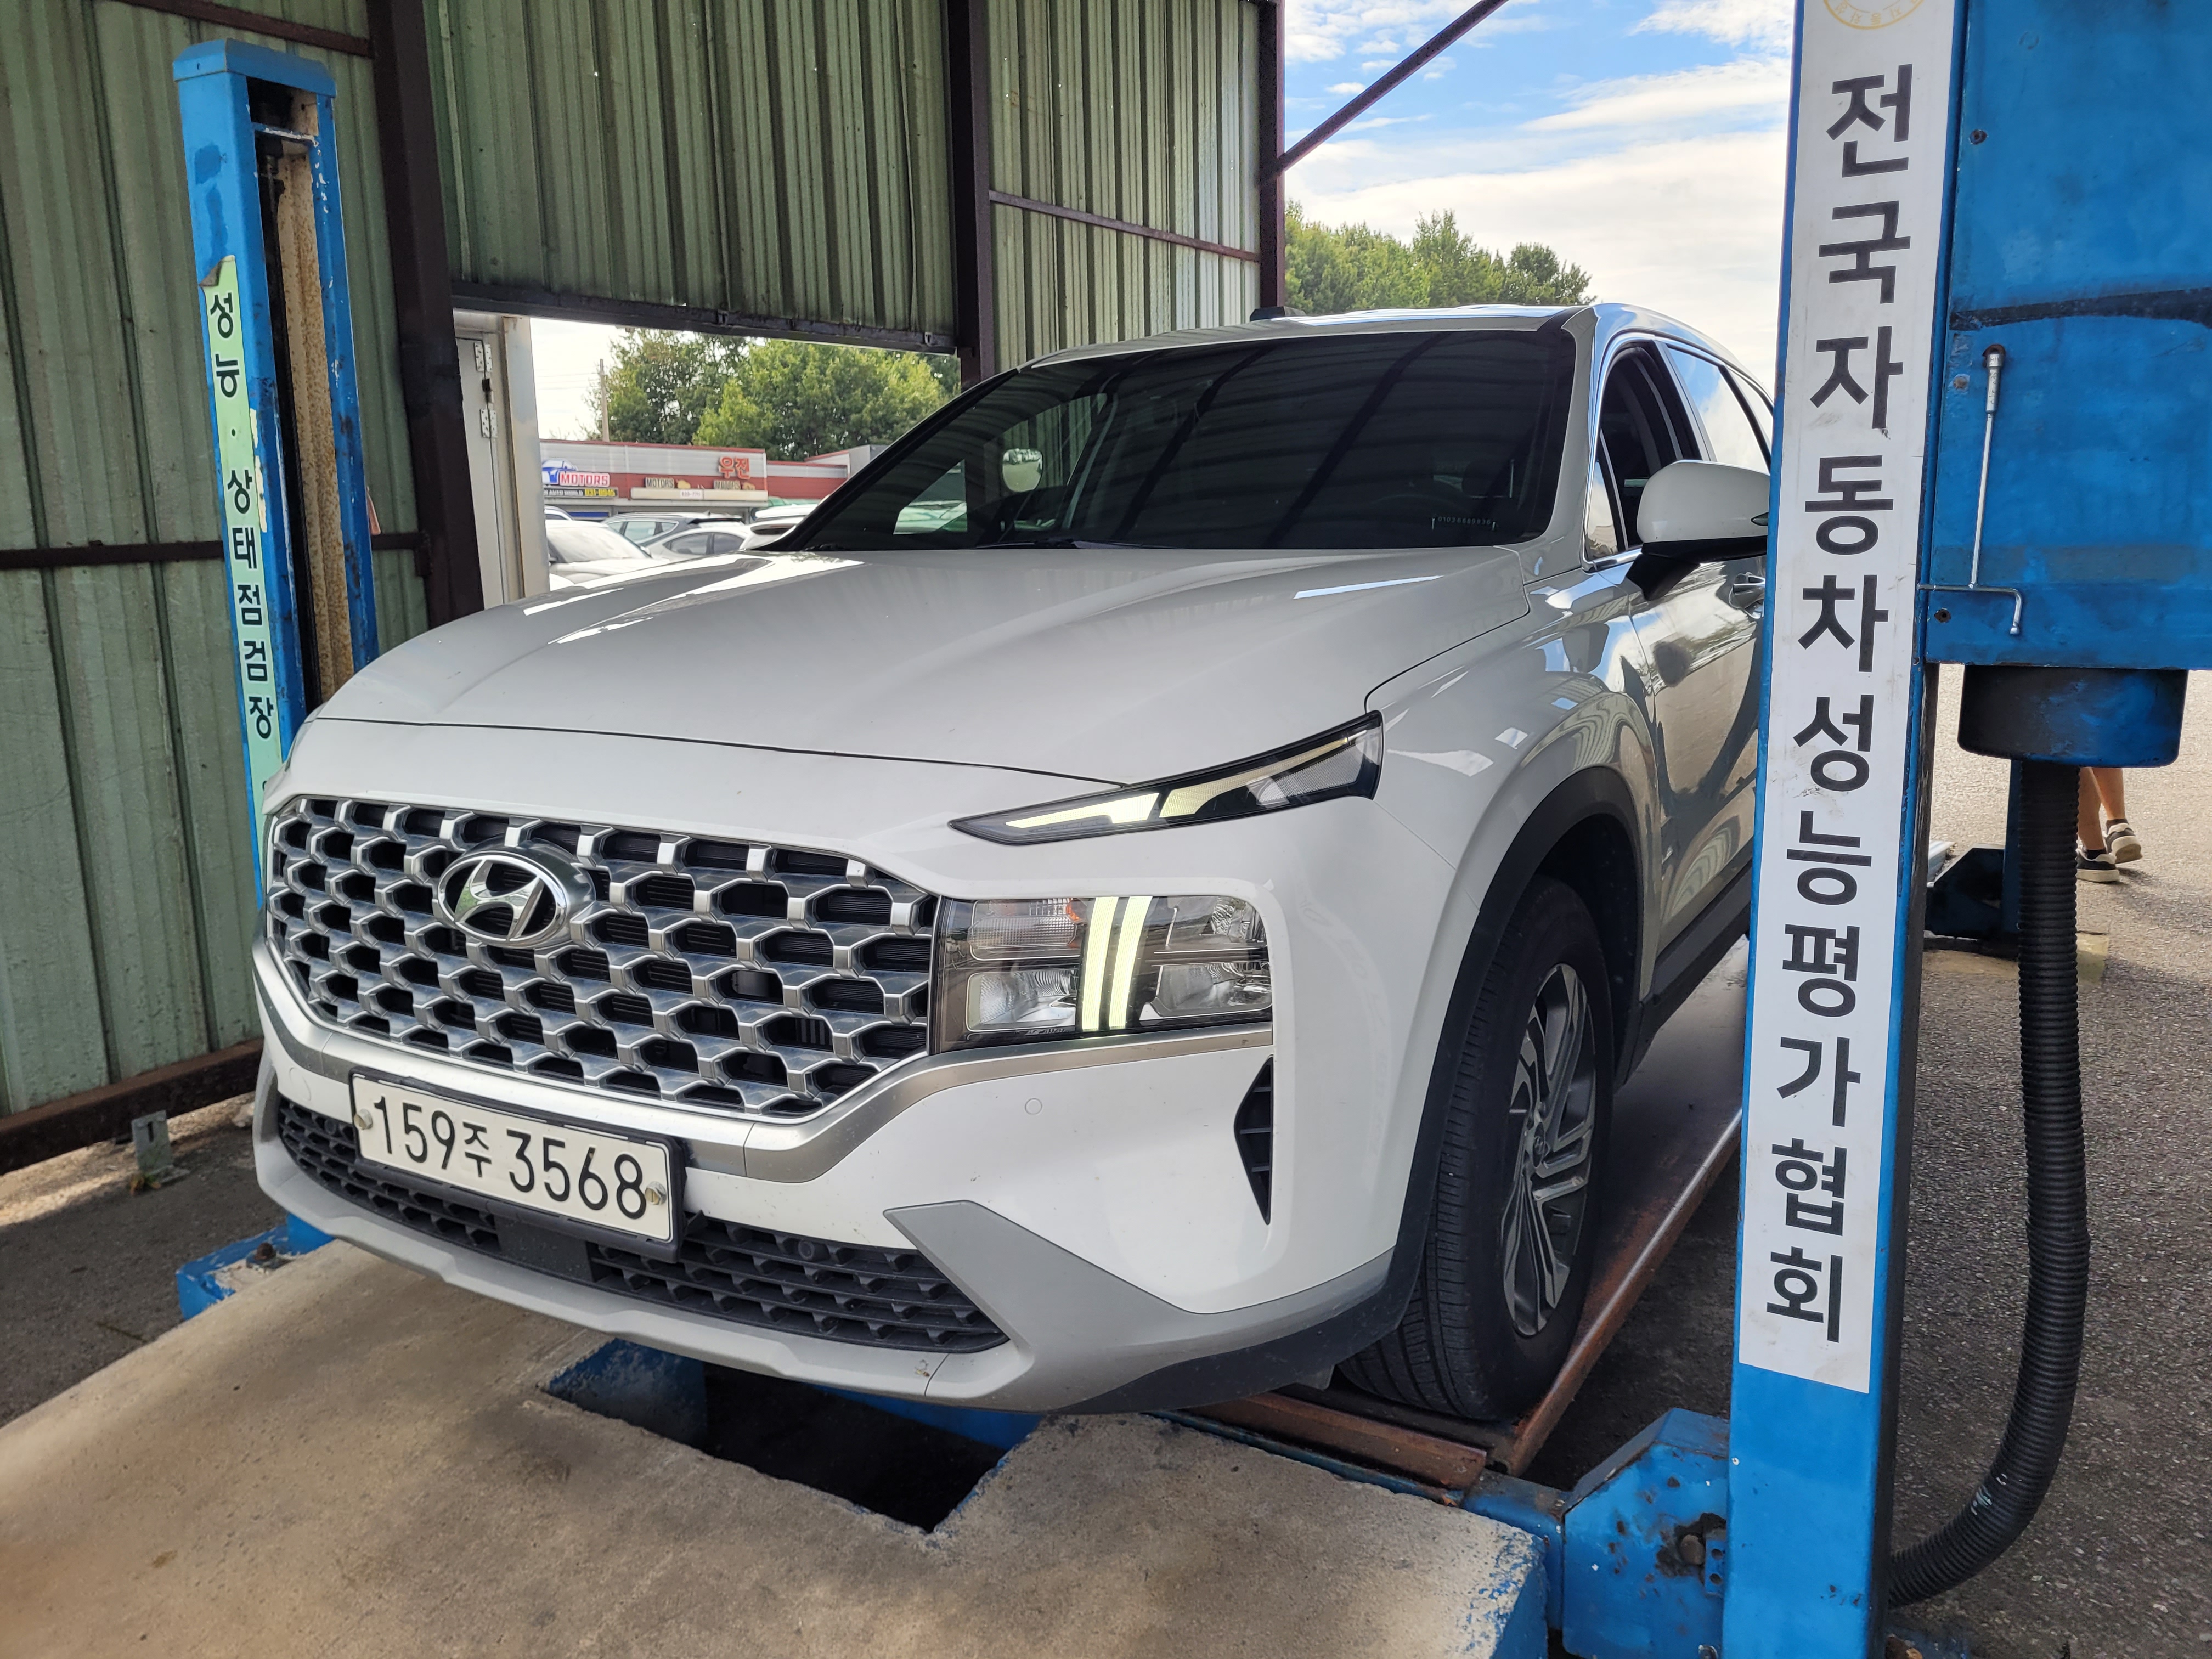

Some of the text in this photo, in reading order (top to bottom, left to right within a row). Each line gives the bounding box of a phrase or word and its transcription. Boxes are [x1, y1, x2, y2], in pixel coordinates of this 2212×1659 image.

[720, 456, 750, 479] 우진
[560, 473, 609, 486] MOTORS
[646, 478, 674, 488] MOTORS
[1766, 64, 1914, 1344] 전국자동차성능평가협회
[373, 1096, 647, 1220] 159주 3568
